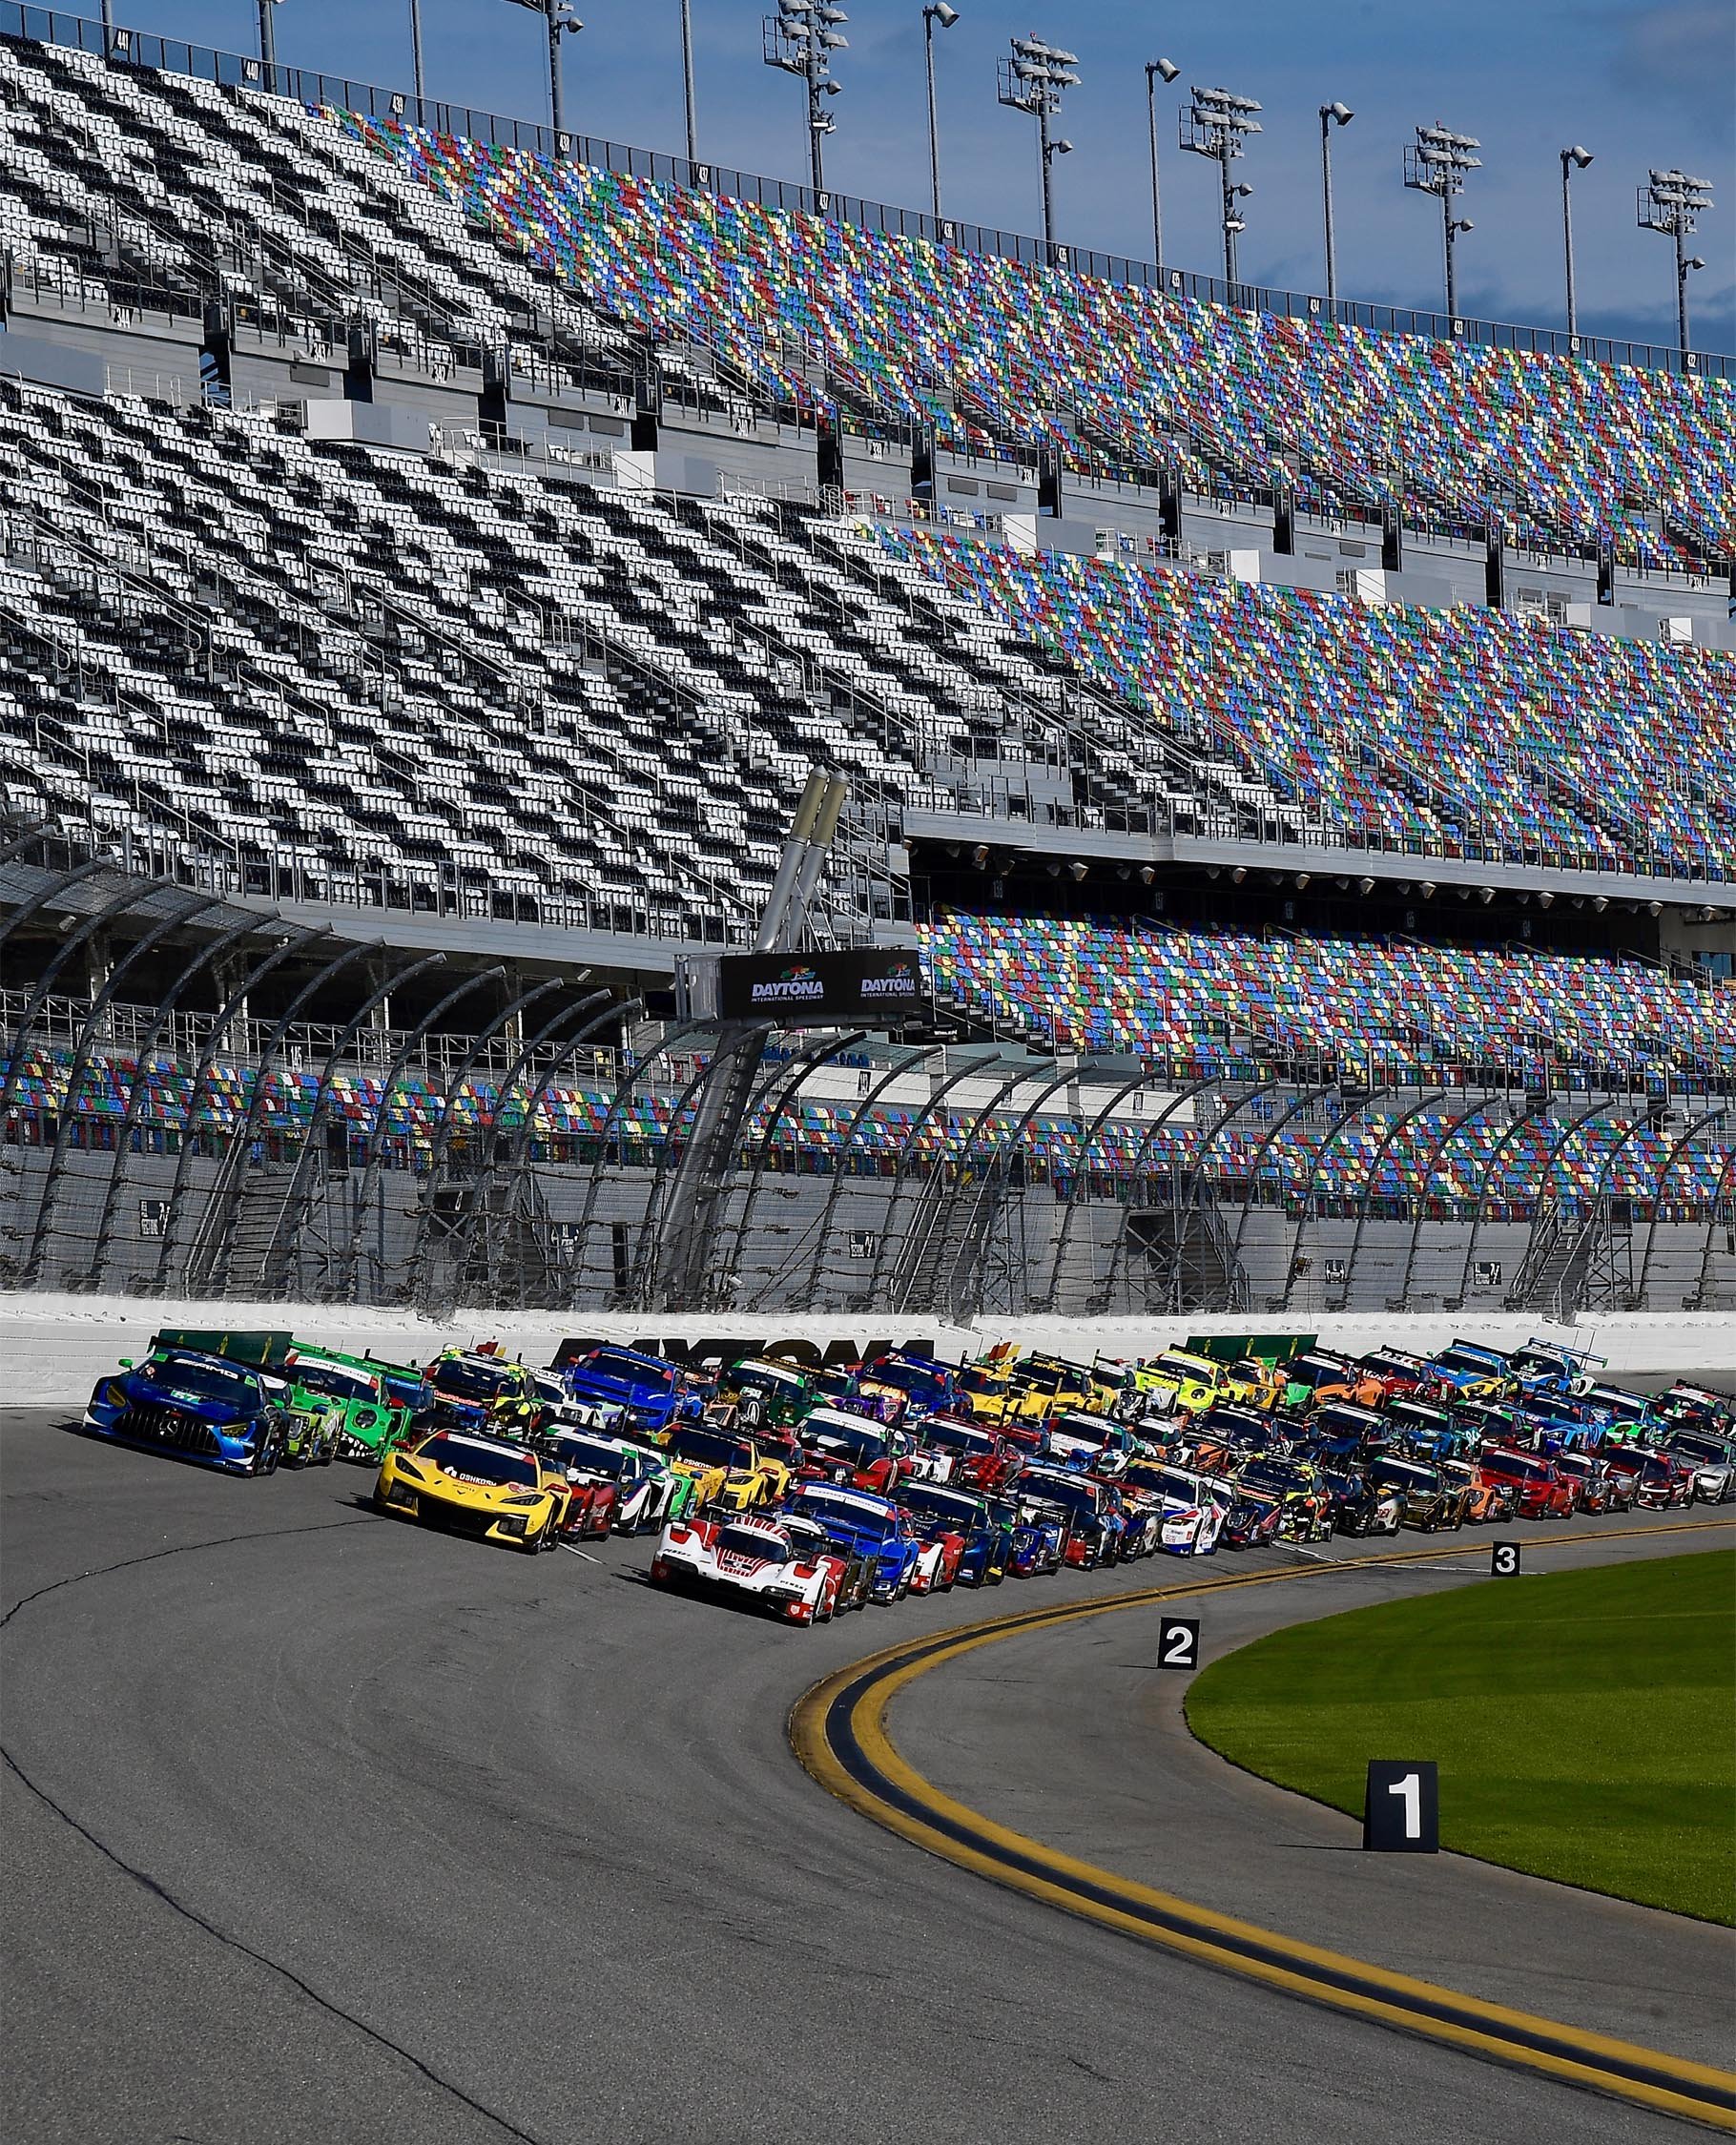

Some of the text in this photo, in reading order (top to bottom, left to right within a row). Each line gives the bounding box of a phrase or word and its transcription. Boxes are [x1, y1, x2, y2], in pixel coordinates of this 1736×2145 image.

[117, 31, 129, 52] 441
[245, 61, 258, 81] 440
[116, 306, 131, 329] 344
[313, 342, 326, 363] 343
[434, 364, 446, 383] 342
[752, 980, 824, 997] DAYTONA
[860, 978, 915, 992] DAYTONA
[193, 1363, 238, 1379] AMG
[174, 1391, 200, 1404] 57
[460, 1474, 497, 1486] OSHKOSH
[1496, 1547, 1516, 1573] 3
[1164, 1625, 1192, 1664] 2
[1388, 1773, 1422, 1839] 1
